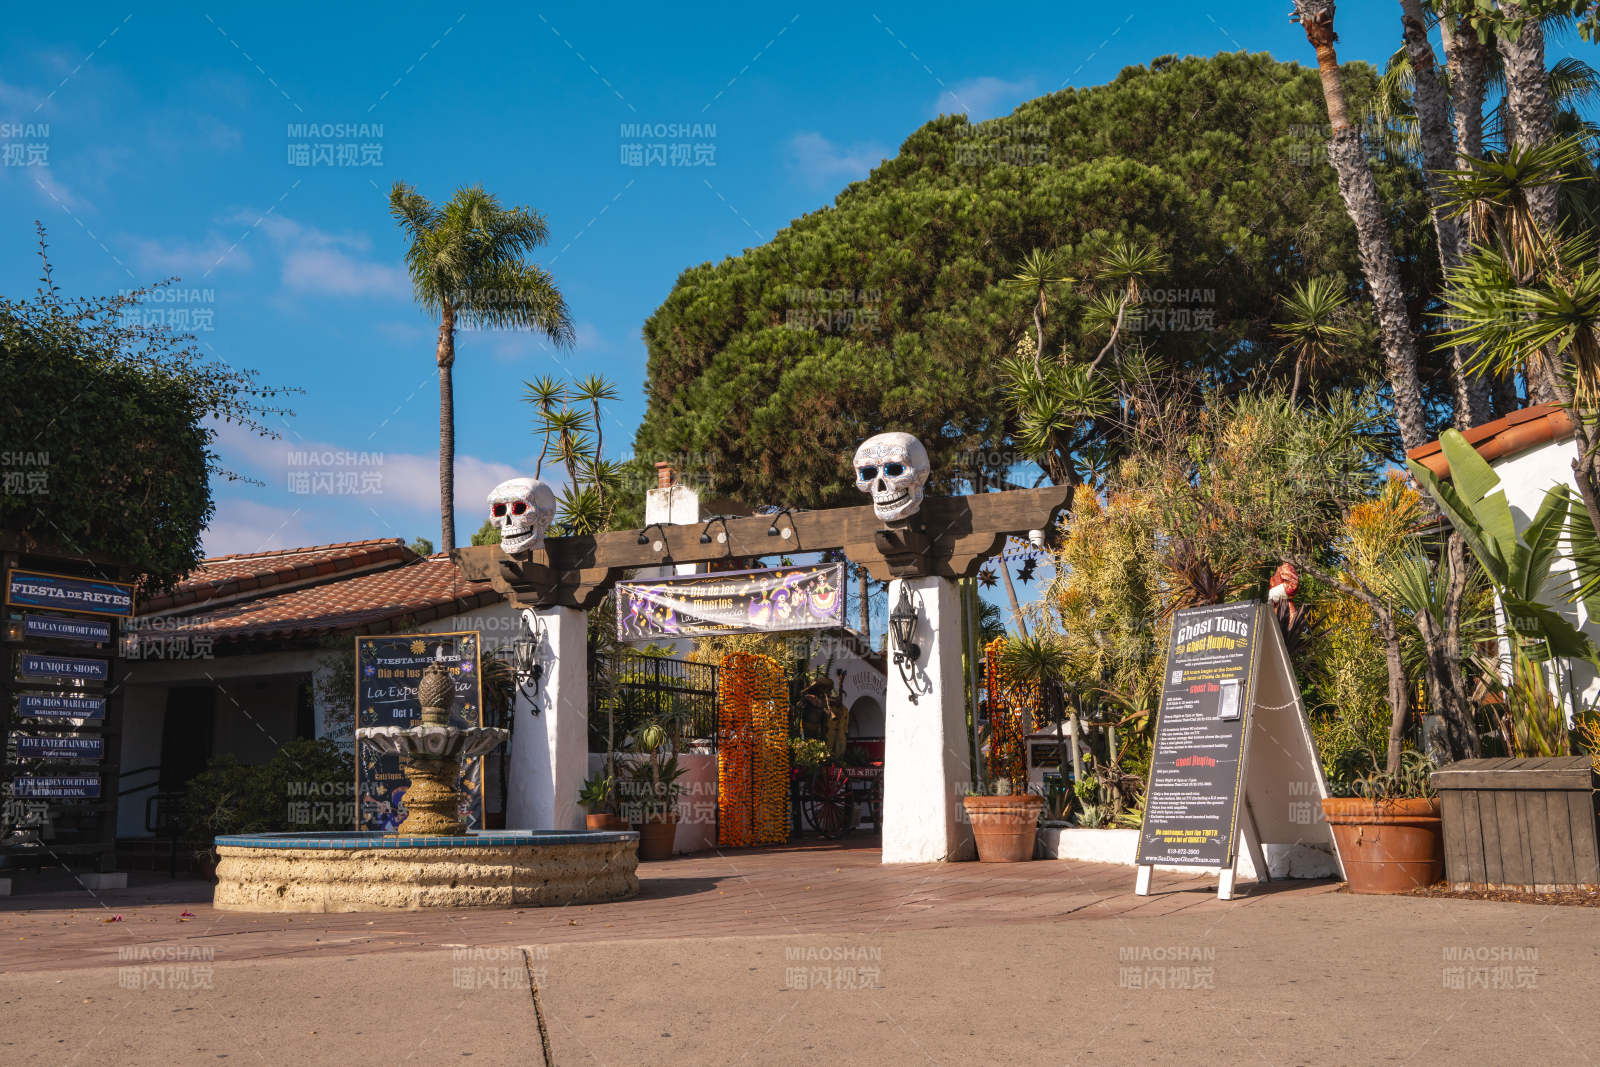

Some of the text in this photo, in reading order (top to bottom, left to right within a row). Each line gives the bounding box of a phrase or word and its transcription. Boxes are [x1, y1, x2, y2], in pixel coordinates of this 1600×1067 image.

[11, 583, 131, 606] FIESTA DE REYES
[708, 585, 720, 597] de
[722, 584, 736, 595] los
[693, 598, 733, 611] Muertos
[28, 621, 57, 632] MEXICAN
[58, 624, 89, 635] COMFORT
[1177, 616, 1248, 644] Ghost Tours
[1186, 635, 1235, 653] Ghost Hunting
[29, 661, 103, 675] 19 UNIQUE SHOPS.
[394, 669, 404, 678] de
[407, 668, 420, 678] los
[367, 687, 386, 699] La
[1190, 684, 1206, 694] Ghost
[26, 697, 42, 706] LOS
[43, 698, 61, 707] RIOS
[392, 708, 406, 718] Oct
[22, 738, 100, 749] LIVE ENTERTAINMENT!
[1176, 755, 1216, 768] Ghost Hunting
[19, 778, 35, 786] LUSH
[36, 778, 61, 786] GARDEN
[32, 788, 62, 796] OUTDOOR
